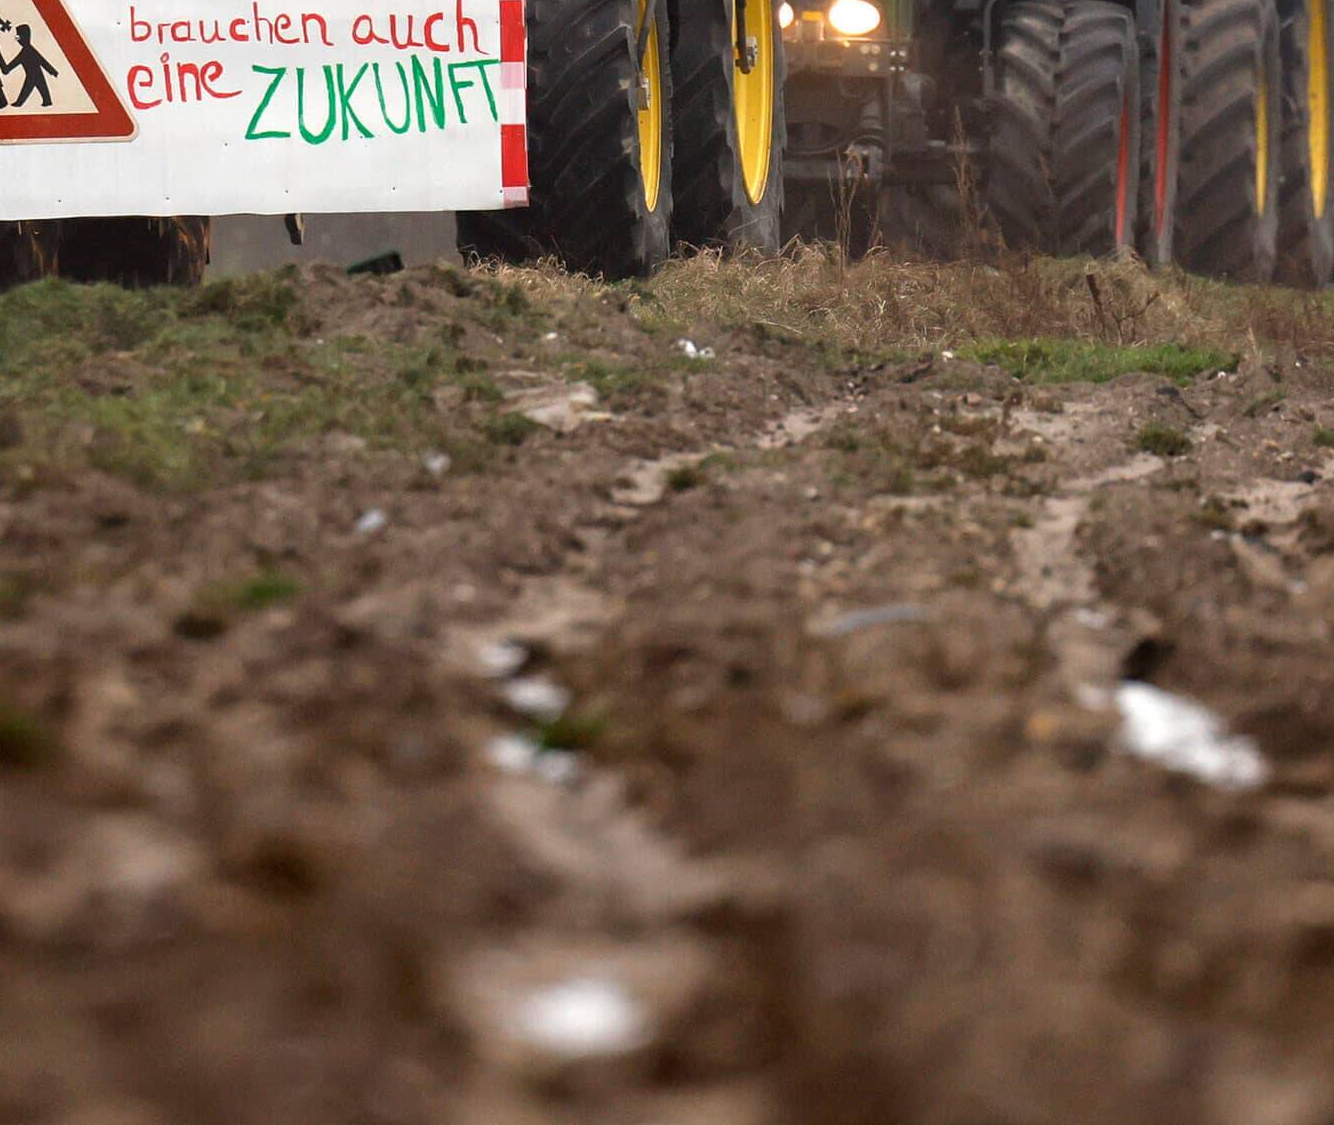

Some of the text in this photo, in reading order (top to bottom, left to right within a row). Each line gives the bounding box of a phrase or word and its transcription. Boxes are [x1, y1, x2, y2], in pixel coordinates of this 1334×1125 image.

[130, 2, 334, 46] brauchen
[127, 52, 501, 145] eine ZUKUNFT
